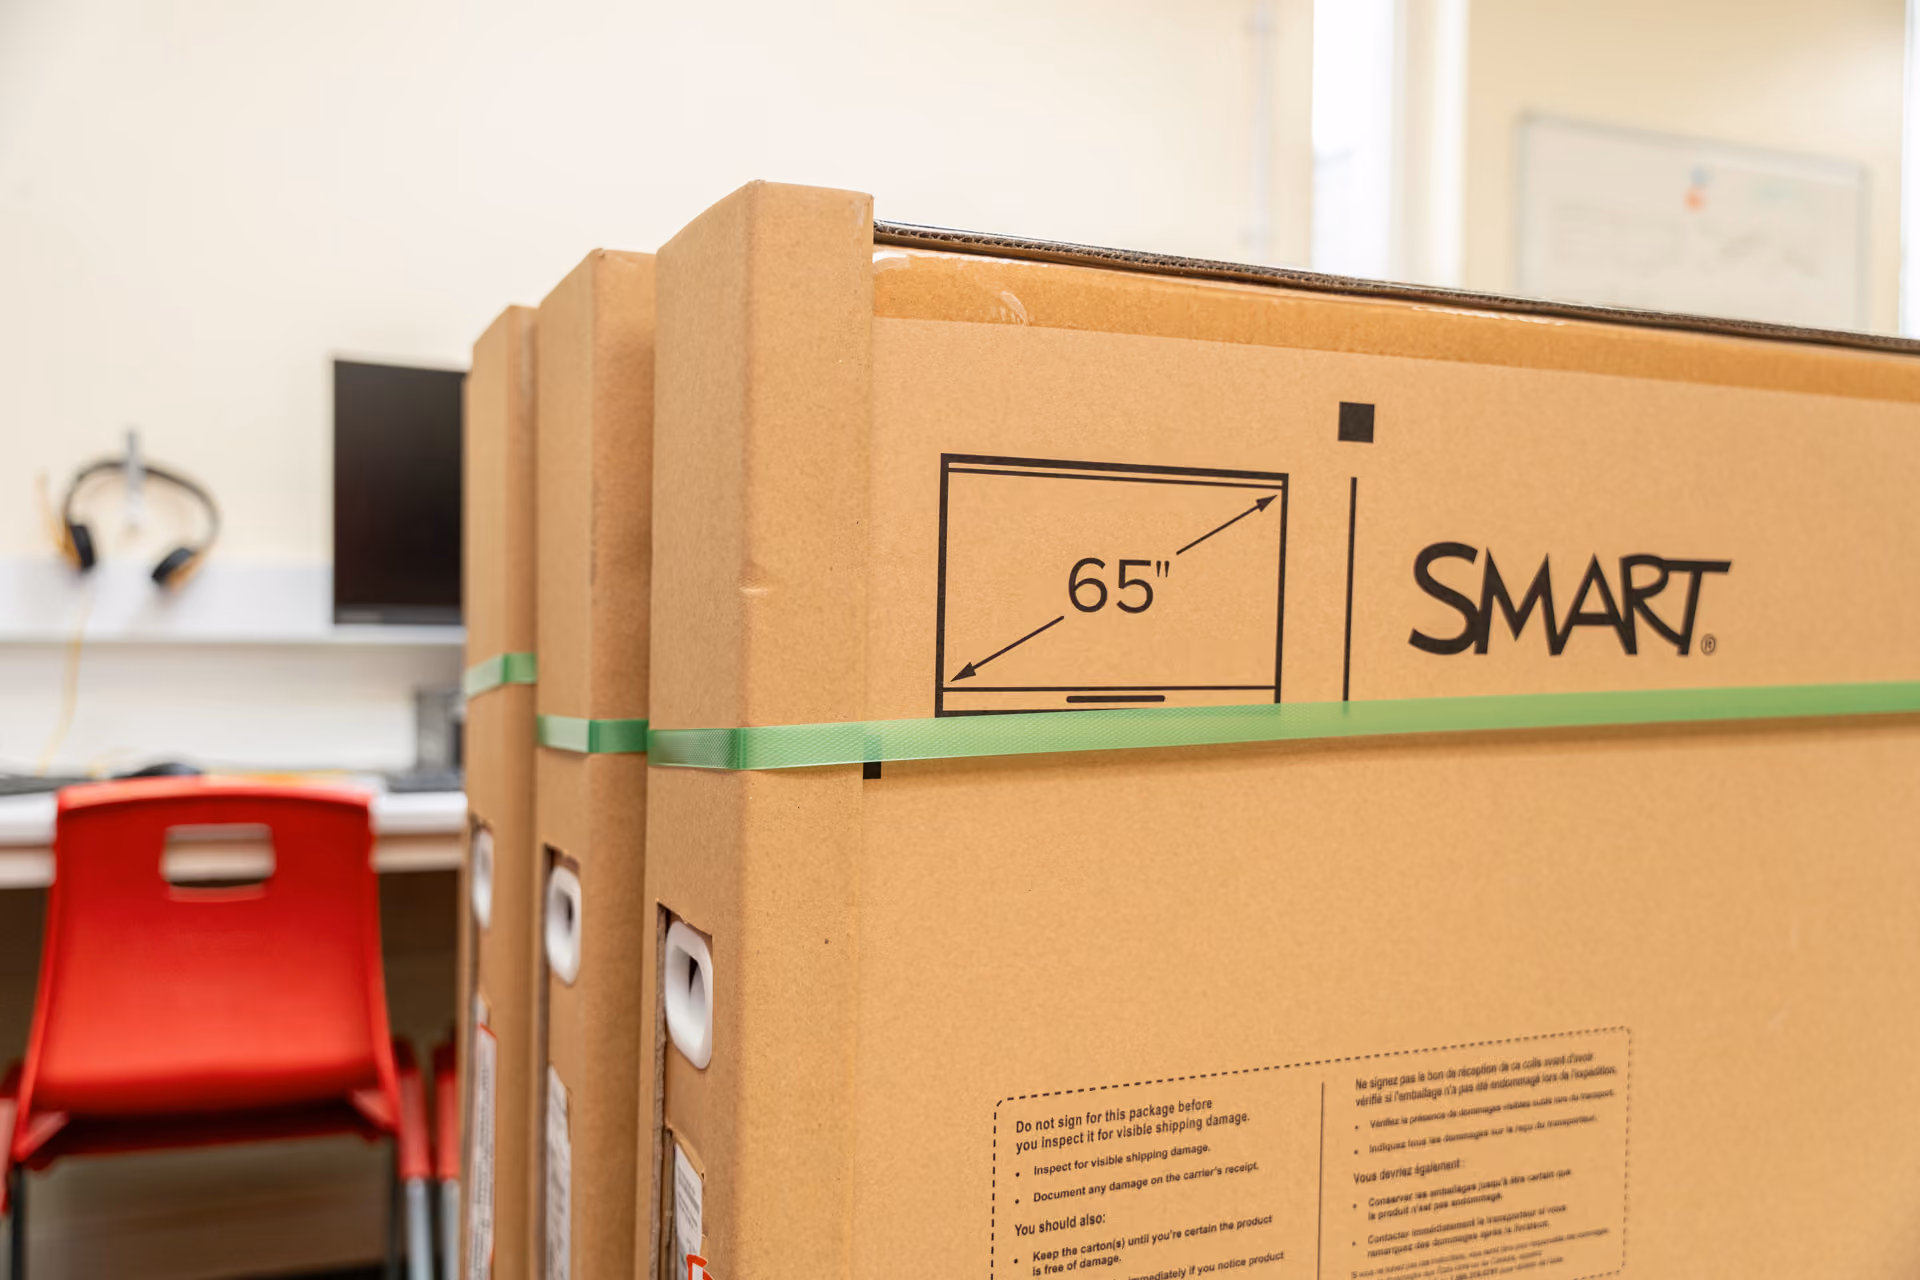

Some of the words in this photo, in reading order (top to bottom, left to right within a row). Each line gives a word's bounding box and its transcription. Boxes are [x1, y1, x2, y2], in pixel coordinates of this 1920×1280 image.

[1068, 557, 1170, 614] 65"
[1016, 1120, 1032, 1133] Do
[1035, 1117, 1055, 1131] not
[1058, 1114, 1082, 1130] sign
[1086, 1112, 1102, 1125] for
[1105, 1108, 1126, 1122] this
[1129, 1103, 1175, 1121] package
[1178, 1098, 1213, 1113] before
[1016, 1140, 1038, 1155] you
[1041, 1132, 1084, 1149] inspect
[1087, 1130, 1095, 1143] it
[1098, 1128, 1114, 1141] for
[1117, 1122, 1153, 1139] visible
[1155, 1117, 1203, 1134] shipping
[1206, 1113, 1251, 1126] damage.
[1033, 1161, 1072, 1176] Inspect
[1074, 1160, 1089, 1170] for
[1091, 1154, 1124, 1168] visible
[1126, 1149, 1168, 1163] shipping
[1170, 1144, 1212, 1156] damage.
[1033, 1186, 1086, 1203] Document
[1088, 1184, 1107, 1197] any
[1109, 1178, 1149, 1191] damage
[1150, 1176, 1164, 1185] on
[1165, 1172, 1181, 1183] the
[1224, 1161, 1259, 1173] receipt.
[1353, 1171, 1377, 1184] Vous
[1014, 1223, 1036, 1237] You
[1039, 1215, 1077, 1233] should
[1080, 1212, 1106, 1227] also:
[1033, 1250, 1060, 1262] Keep
[1061, 1246, 1078, 1257] the
[1080, 1237, 1126, 1254] carton(s)
[1128, 1233, 1150, 1246] until
[1184, 1223, 1217, 1237] certain
[1219, 1220, 1235, 1231] the
[1236, 1214, 1273, 1231] product
[1032, 1266, 1041, 1277] is
[1044, 1263, 1064, 1275] free
[1066, 1259, 1078, 1271] of
[1079, 1254, 1122, 1269] damage.
[1188, 1265, 1196, 1275] if
[1197, 1263, 1216, 1277] you
[1217, 1258, 1247, 1271] notice
[1248, 1251, 1285, 1267] product
